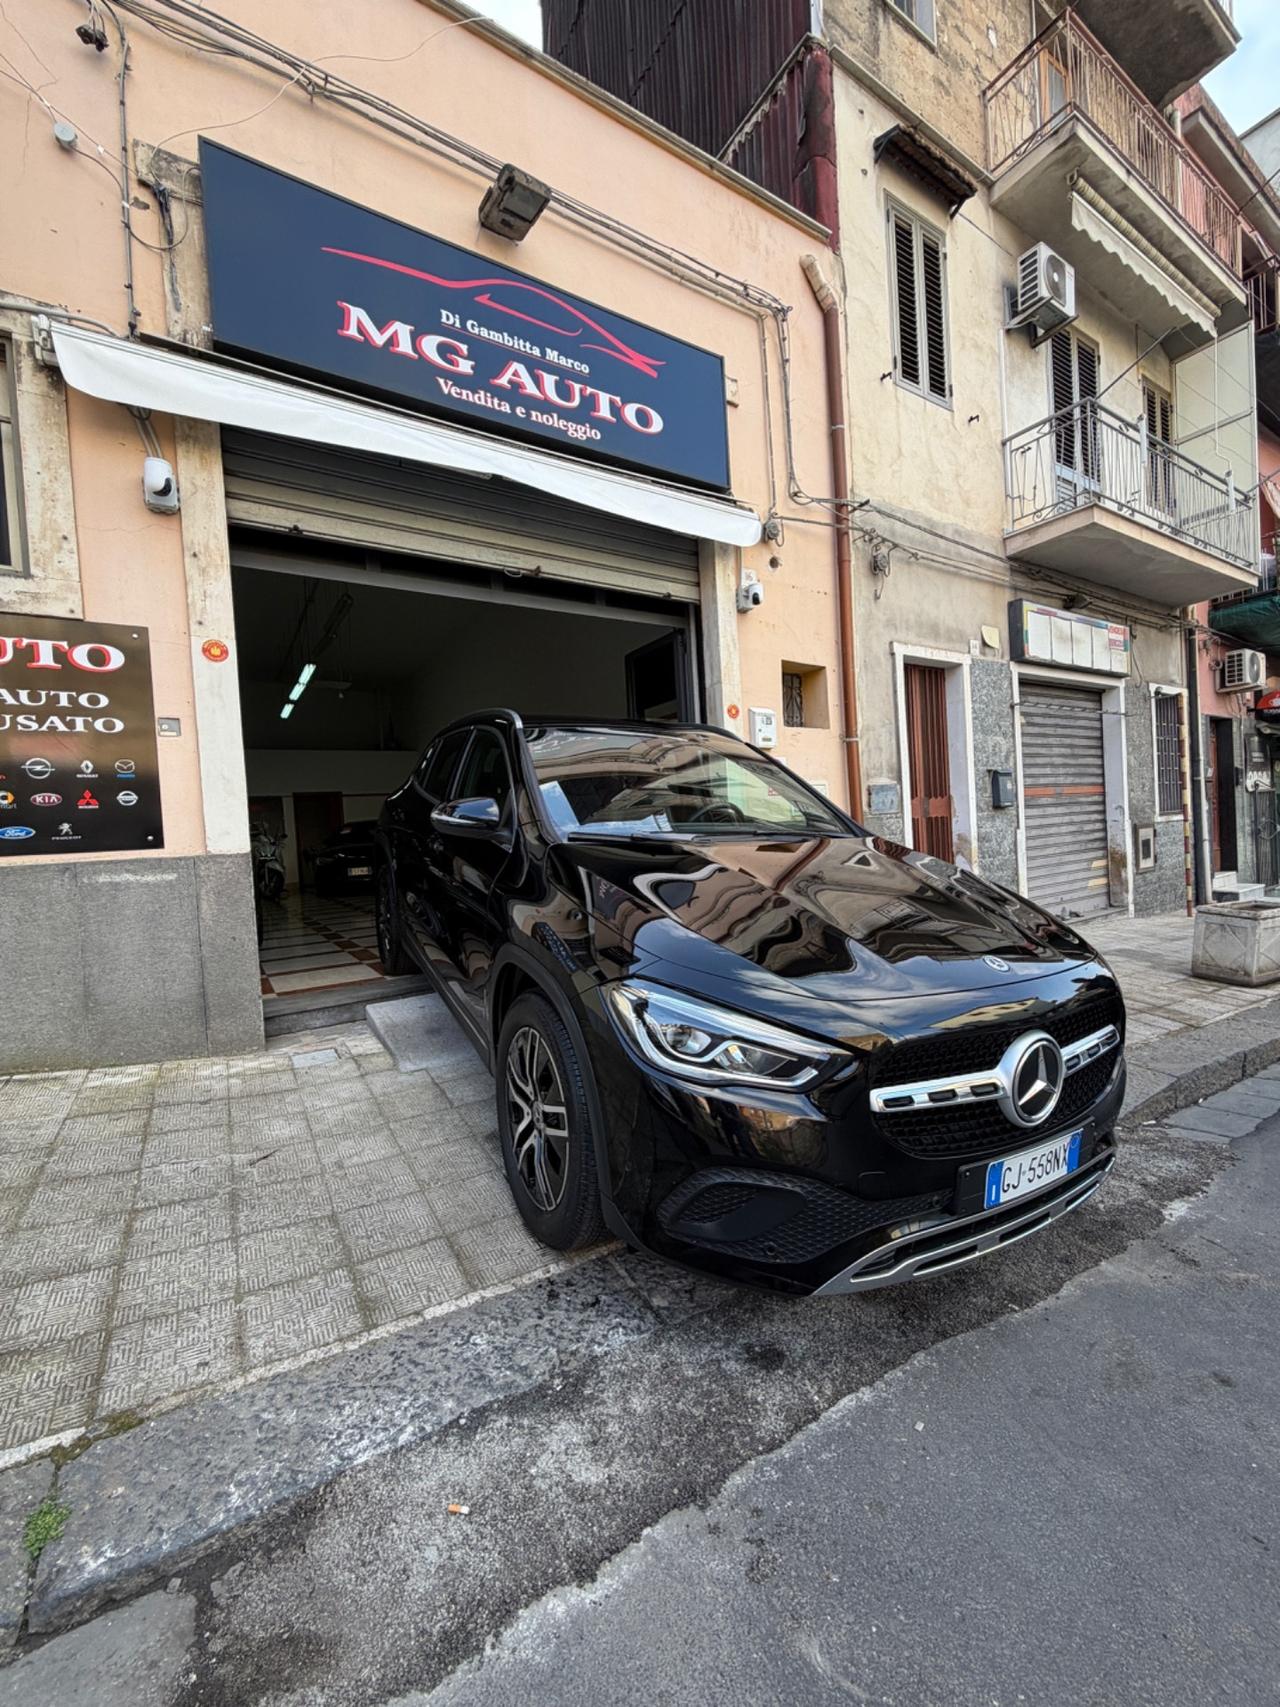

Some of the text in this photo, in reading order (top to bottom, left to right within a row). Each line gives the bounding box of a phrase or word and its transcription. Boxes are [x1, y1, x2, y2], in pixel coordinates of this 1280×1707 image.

[336, 300, 664, 435] MG AUTO
[440, 309, 590, 374] Di Gambitta Marco
[435, 376, 602, 440] Vendita e noleggio
